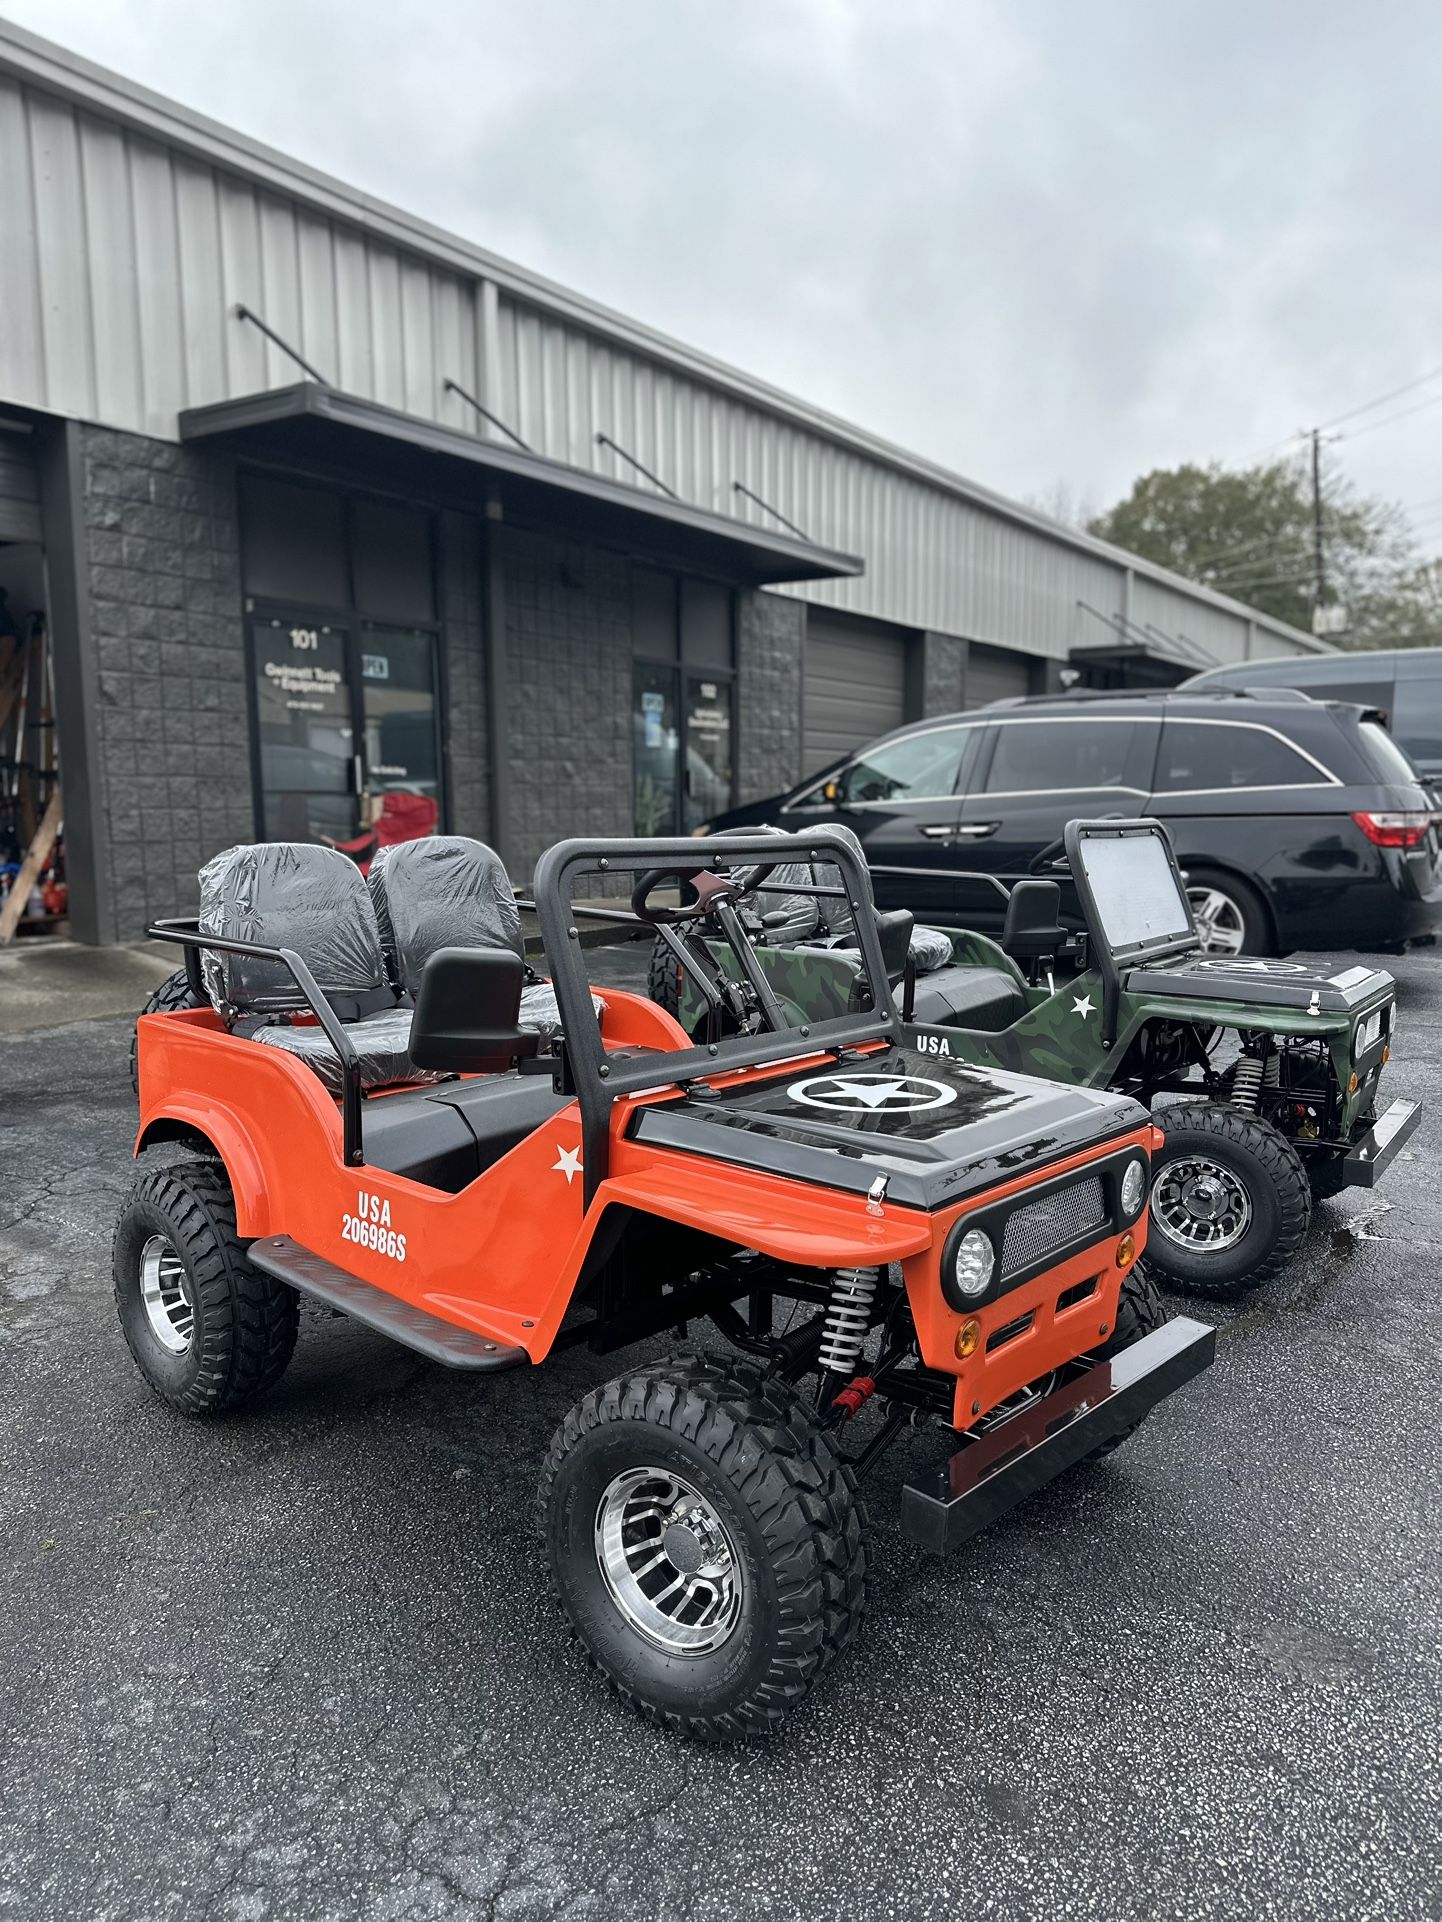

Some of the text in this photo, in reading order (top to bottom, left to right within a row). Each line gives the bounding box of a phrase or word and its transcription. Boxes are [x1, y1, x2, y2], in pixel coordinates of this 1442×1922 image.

[289, 628, 318, 650] 101
[917, 1035, 950, 1055] USA
[358, 1190, 391, 1228] USA
[341, 1213, 407, 1262] 206986S
